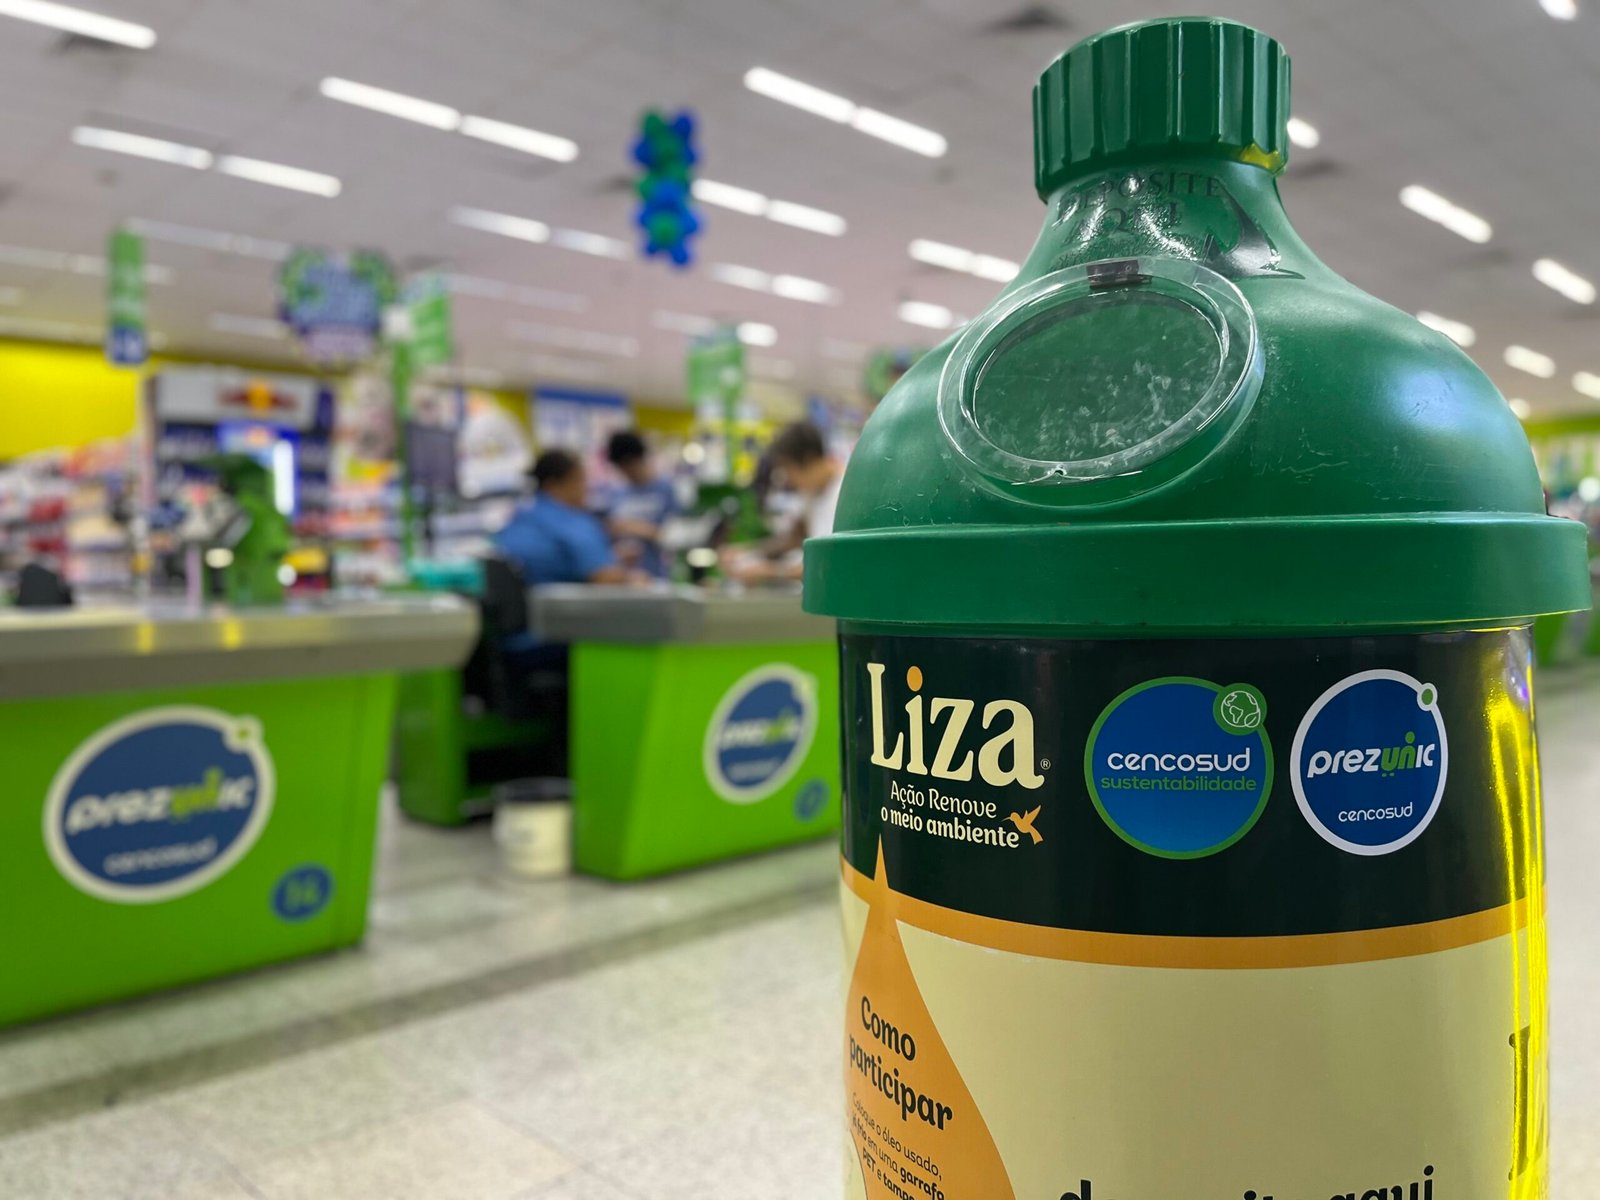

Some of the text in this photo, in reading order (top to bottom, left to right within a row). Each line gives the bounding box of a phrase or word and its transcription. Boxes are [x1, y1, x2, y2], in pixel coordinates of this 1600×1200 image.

[1107, 747, 1251, 772] cencosud
[1307, 731, 1435, 778] prezunic
[891, 780, 997, 818] Ação Renove
[1101, 776, 1257, 792] sustentabilidade
[881, 804, 1020, 848] o meio ambiente
[1338, 802, 1413, 822] cencosud
[861, 995, 916, 1061] Como
[849, 1034, 953, 1130] participar
[863, 1146, 876, 1172] PET
[877, 1168, 882, 1180] e
[867, 1136, 878, 1155] em
[879, 1148, 898, 1173] uma
[876, 1124, 882, 1136] o
[882, 1126, 902, 1152] óleo
[903, 1146, 942, 1181] usado,
